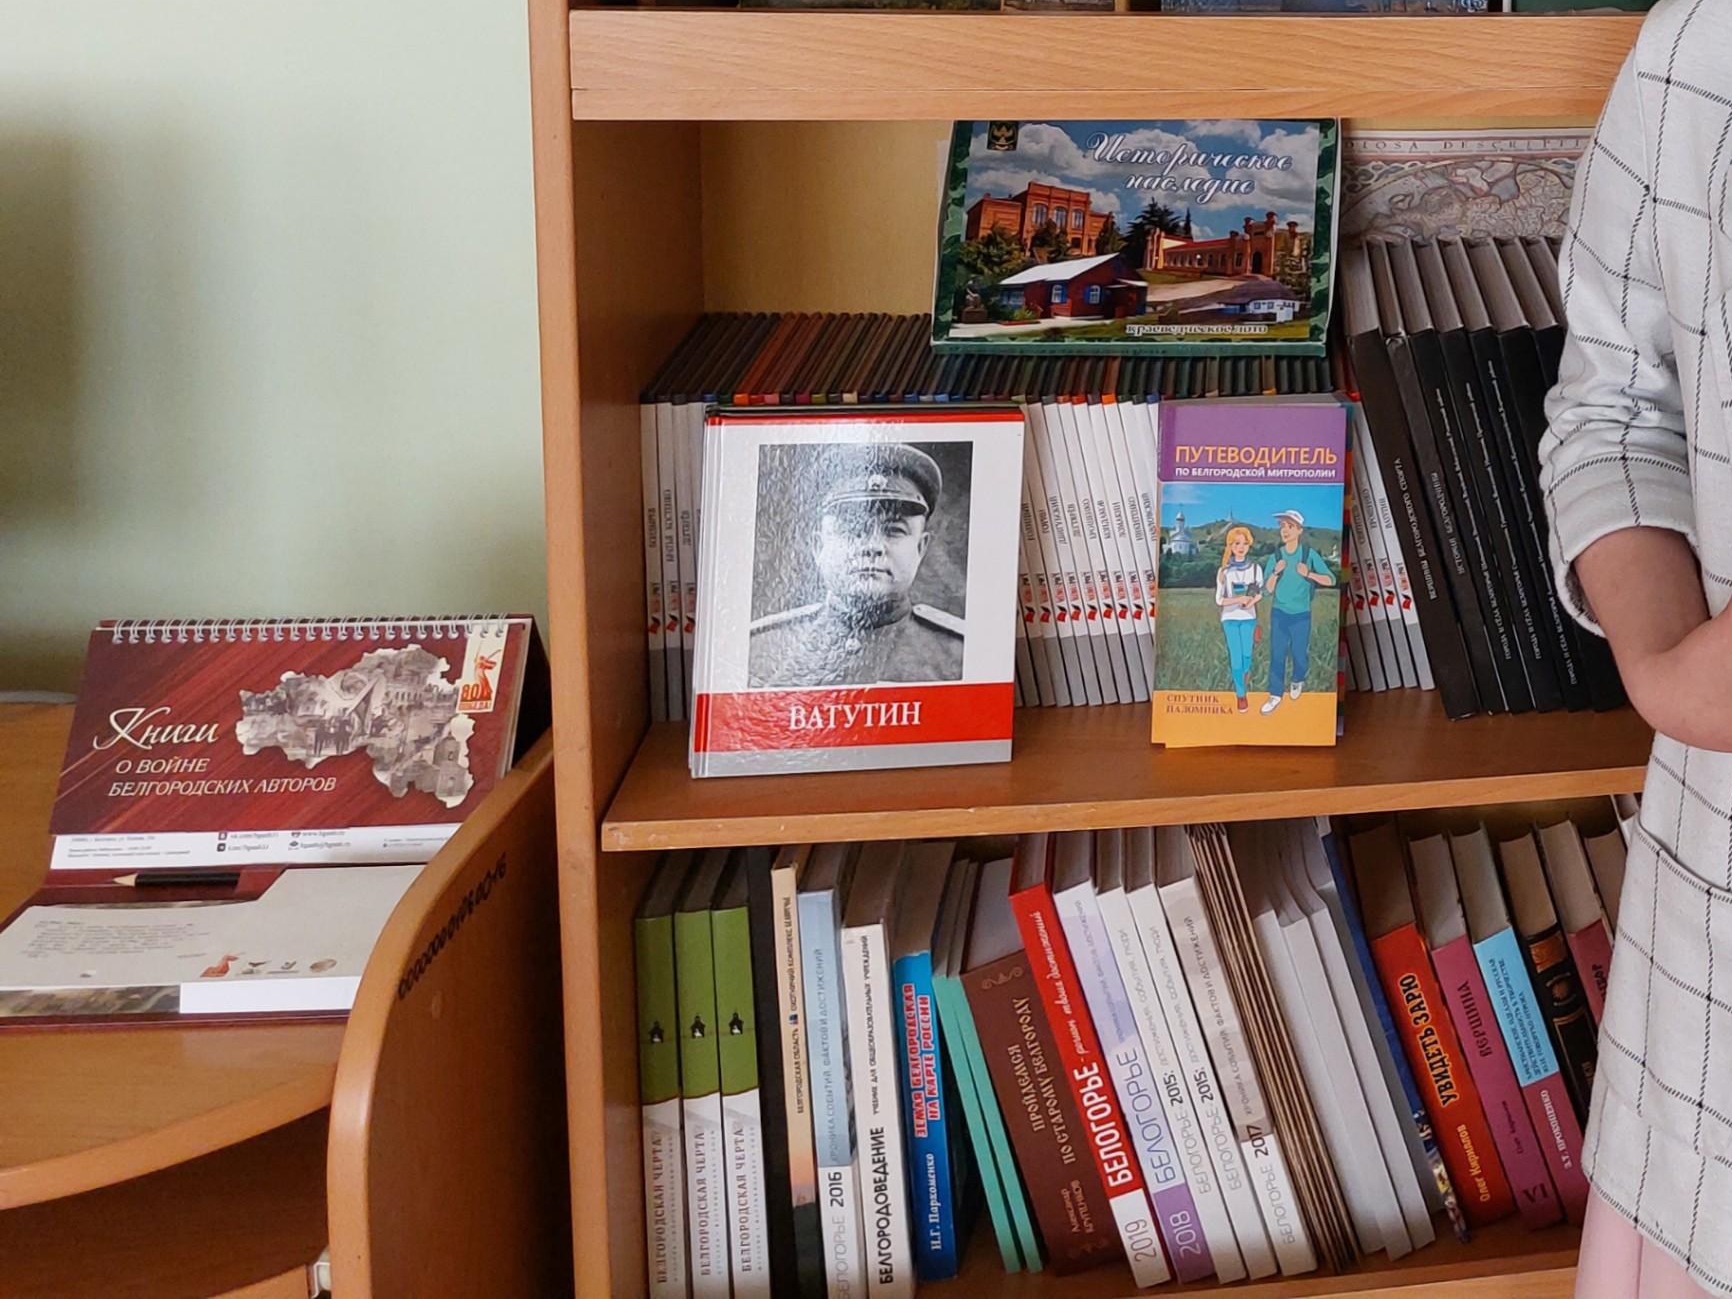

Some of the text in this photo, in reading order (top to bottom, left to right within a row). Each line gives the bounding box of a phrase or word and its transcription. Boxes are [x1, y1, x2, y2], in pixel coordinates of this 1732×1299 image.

[1086, 131, 1294, 175] Историческое
[1124, 171, 1256, 204] наследие
[1175, 444, 1338, 469] ПУТЕВОДИТЕЛЬ
[1175, 467, 1336, 479] ПО БЕЛГОРОДСКОЙ МИТРОПОЛИИ
[461, 683, 480, 701] 80
[788, 701, 922, 731] ВАТУТИН
[1166, 693, 1220, 704] СПУТНИК
[1166, 704, 1234, 716] ПАЛОМНИКА
[94, 706, 220, 753] Книги
[107, 776, 337, 798] БЕЛГОРОДСКИХ АВТОРОВ
[116, 755, 209, 774] О ВОЙНЕ
[1027, 910, 1062, 981] достижений
[1182, 915, 1212, 981] ДОСТИЖЕНИЙ
[813, 948, 827, 1017] ДОСТИЖЕНИЙ
[1013, 997, 1051, 1081] БЕЛГОРОДУ
[1397, 971, 1462, 1107] УВИДЕТЬ ЗАРЮ
[1456, 979, 1494, 1059] ВЕРШИНА
[902, 983, 928, 1138] ЗЕМЛЯ БЕЛГОРОДСКАЯ
[917, 995, 941, 1121] НА КАРТЕ РОССИИ
[1191, 1065, 1216, 1104] 2015:
[794, 1060, 804, 1114] БЕЛГОРОДСКАЯ
[1041, 1083, 1071, 1142] СТАРОМУ
[1160, 1069, 1185, 1107] 2015:
[1073, 1061, 1134, 1188] БЕЛОГОРЬЕ
[1117, 1048, 1176, 1184] БЕЛОГОРЬЕ
[1244, 1121, 1271, 1160] 2017
[828, 1170, 845, 1208] 2016
[1454, 1122, 1493, 1203] Олег Кириллов
[651, 1139, 668, 1283] БЕЛГОРОДСКАЯ ЧЕРТА
[694, 1131, 711, 1276] БЕЛГОРОДСКАЯ ЧЕРТА
[733, 1128, 752, 1272] БЕЛГОРОДСКАЯ ЧЕРТА
[870, 1125, 894, 1286] БЕЛГОРОДОВЕДЕНИЕ
[927, 1152, 942, 1251] Н.Г. Пархоменко
[1124, 1219, 1157, 1263] 2019
[1169, 1210, 1201, 1259] 2018
